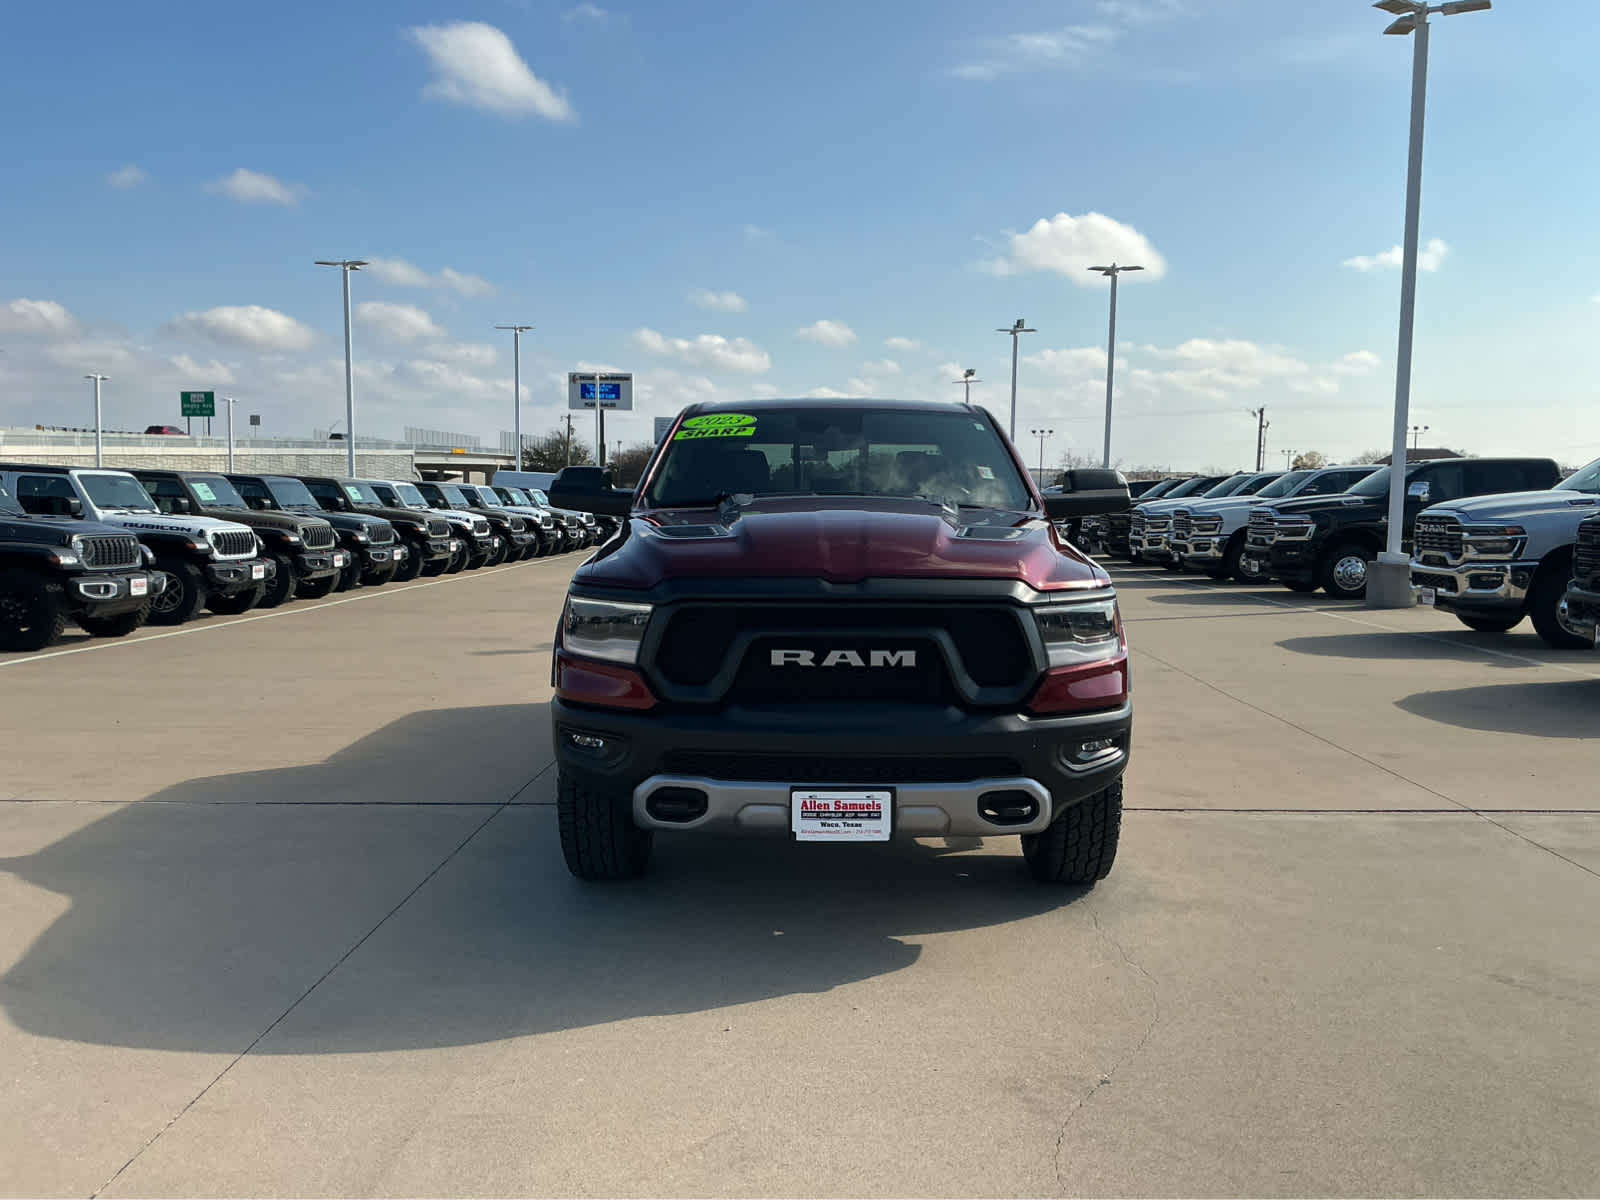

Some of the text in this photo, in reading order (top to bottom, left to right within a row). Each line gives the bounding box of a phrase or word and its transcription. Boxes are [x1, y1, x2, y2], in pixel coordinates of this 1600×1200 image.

[693, 416, 746, 426] 2023
[683, 427, 747, 437] SHARP
[123, 522, 192, 533] RUBICON
[771, 649, 916, 667] RAM
[801, 799, 882, 810] Allen Samuels
[820, 821, 840, 829] Waco,
